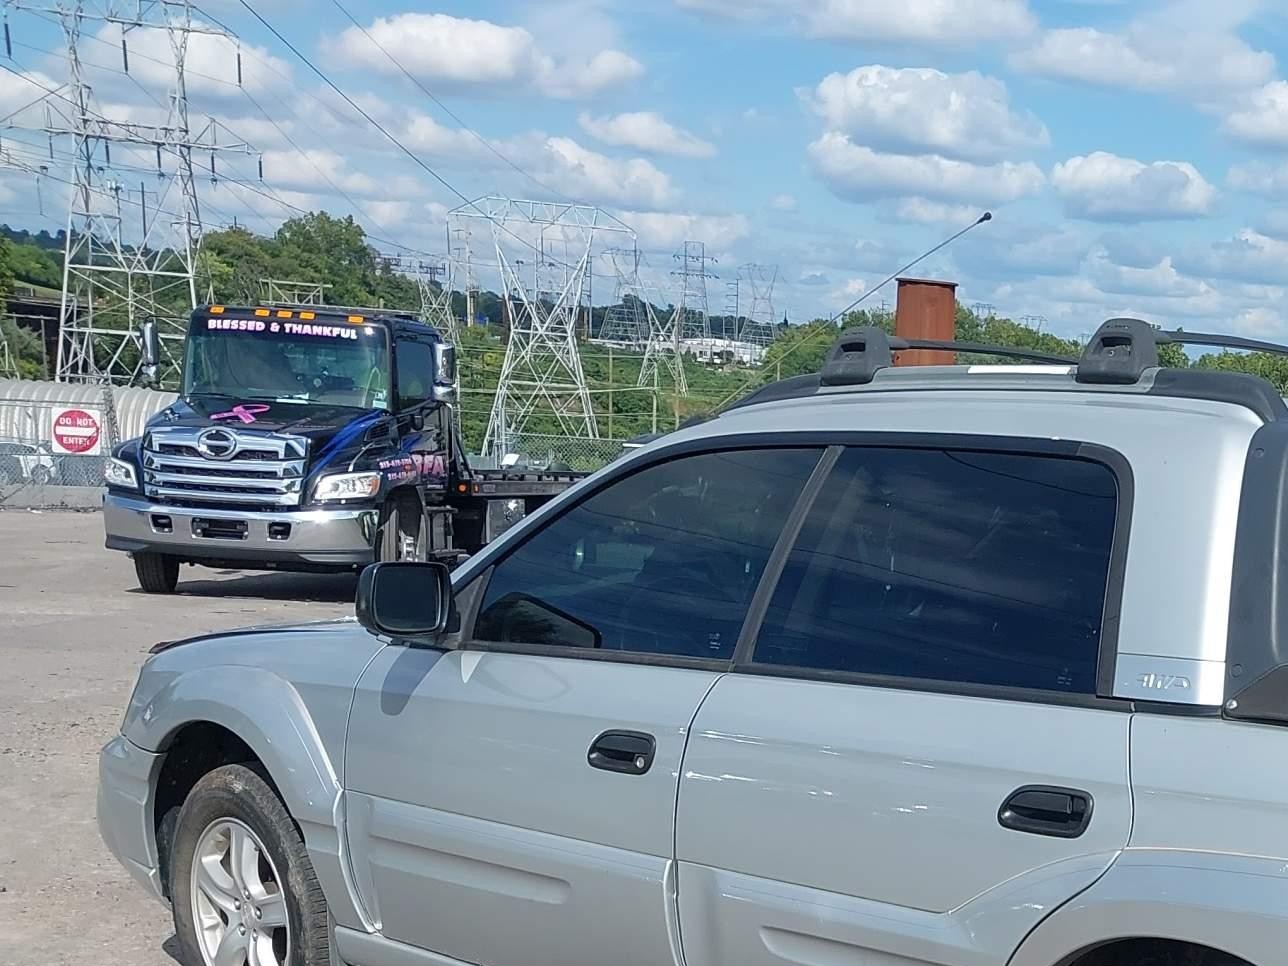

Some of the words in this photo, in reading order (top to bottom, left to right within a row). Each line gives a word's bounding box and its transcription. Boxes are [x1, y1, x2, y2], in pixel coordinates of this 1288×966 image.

[208, 319, 266, 332] BLESSED
[270, 322, 280, 333] &
[284, 322, 358, 340] THANKFUL
[59, 417, 71, 425] DO
[77, 417, 94, 426] NOT
[63, 436, 90, 446] ENTER
